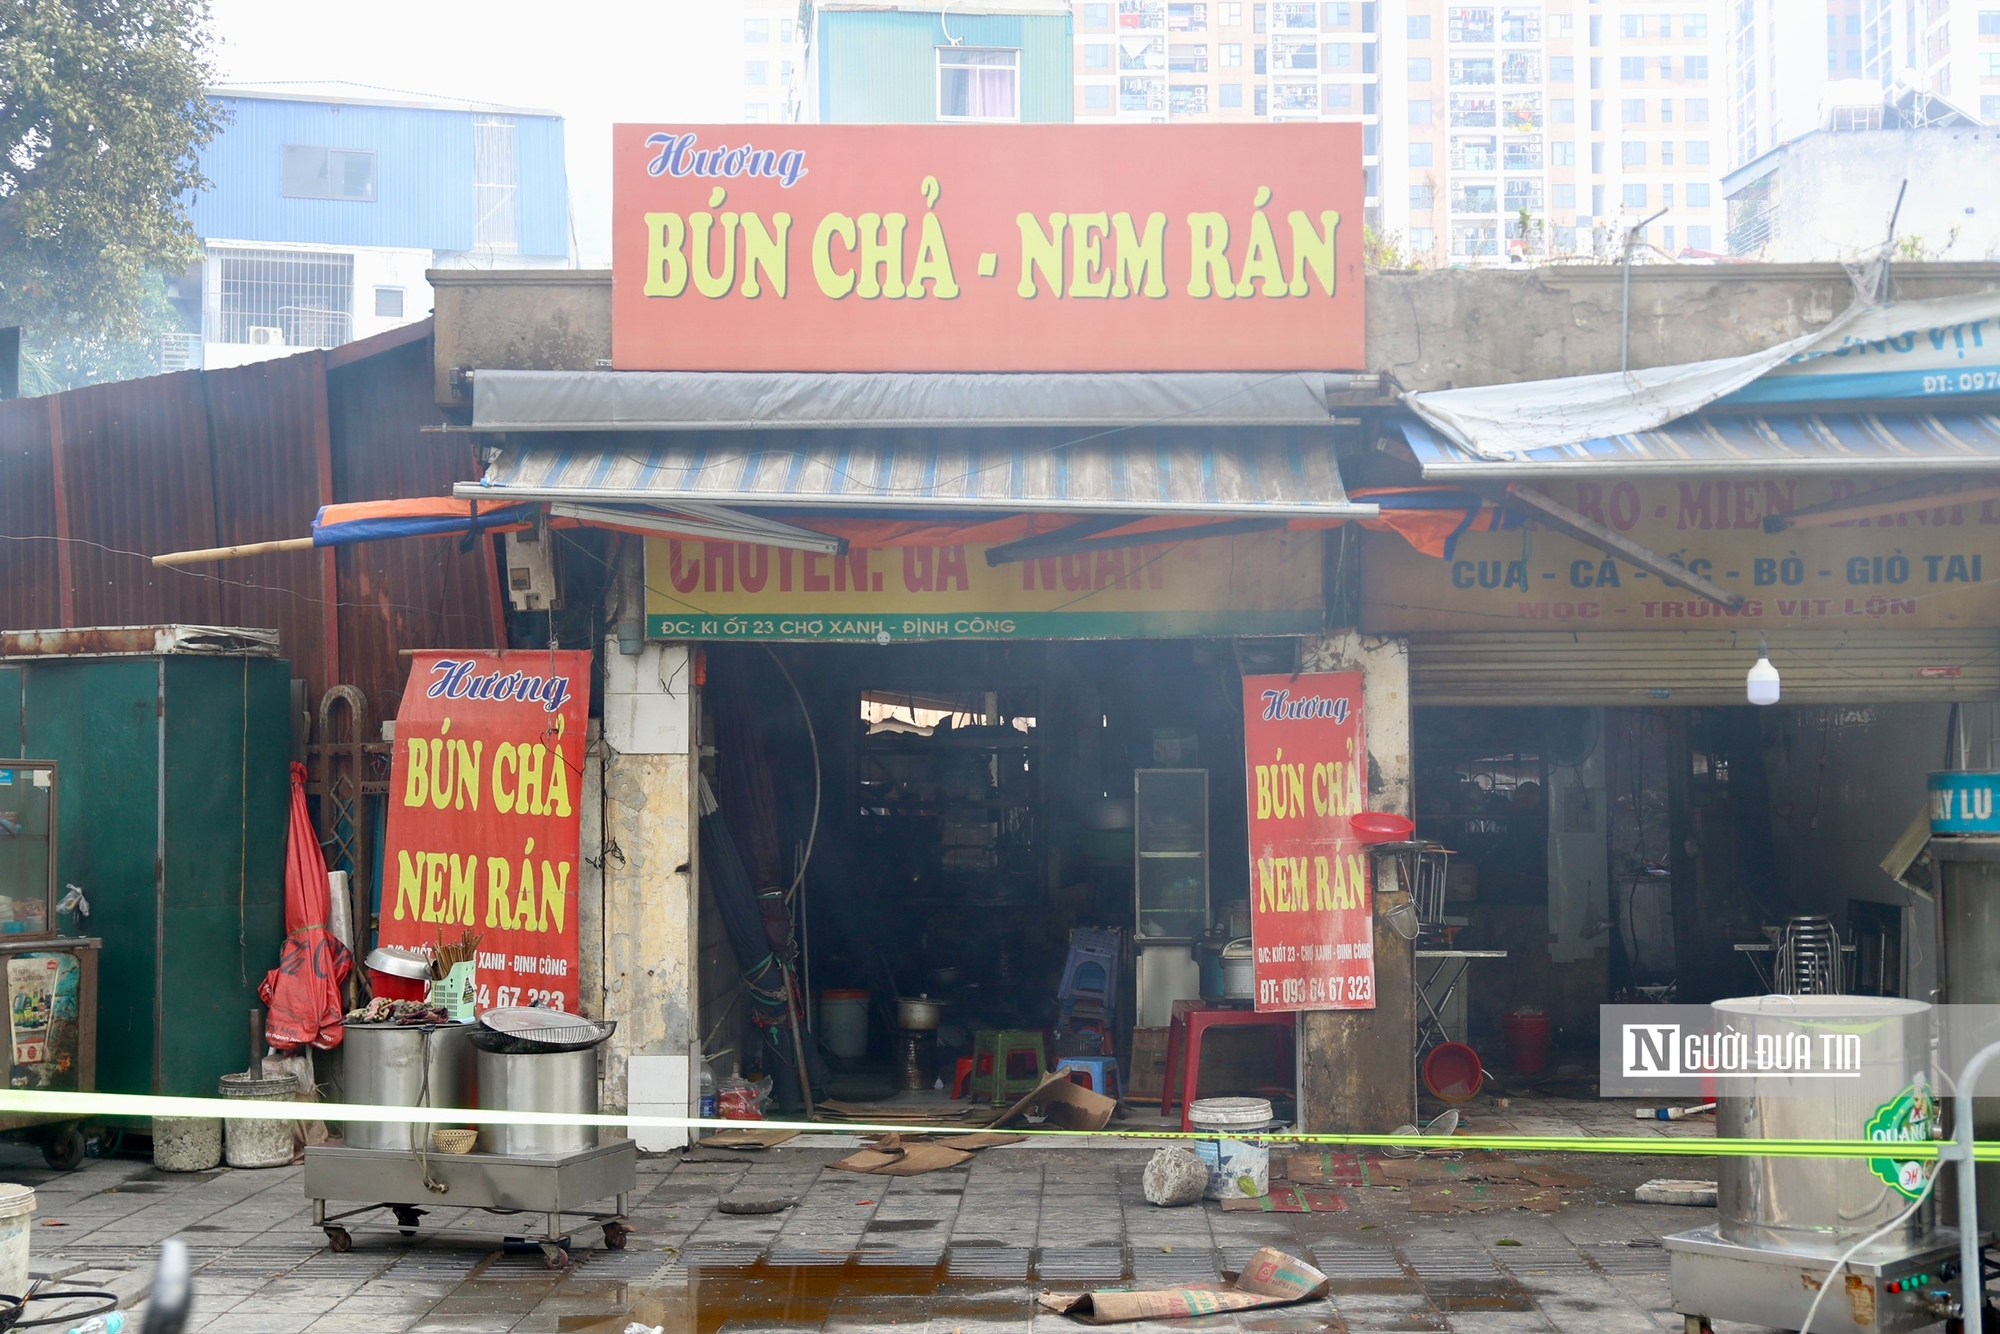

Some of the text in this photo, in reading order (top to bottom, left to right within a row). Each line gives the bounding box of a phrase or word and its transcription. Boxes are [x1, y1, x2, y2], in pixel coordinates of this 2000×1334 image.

[645, 132, 808, 187] Hương
[644, 175, 1340, 298] BÚN CHẢ - NEM RÁN
[1923, 374, 1953, 393] ĐT:
[1452, 560, 1527, 590] CUA
[1754, 549, 1804, 586] BÒ
[1847, 548, 1909, 585] GIÒ
[1923, 554, 1981, 582] TAI
[661, 621, 695, 634] ĐC:
[701, 621, 717, 634] KI
[723, 617, 748, 634] ỐT
[753, 621, 774, 634] 23
[780, 619, 823, 637] CHỢ
[829, 621, 883, 634] XANH
[902, 617, 949, 637] ĐỊNH
[954, 616, 1016, 634] CÔNG
[1776, 599, 1831, 619] VỊT
[426, 659, 572, 712] Hương
[1261, 688, 1350, 724] Hương
[404, 713, 572, 817] BÚN CHẢ
[1255, 736, 1362, 819] BÚN CHẢ
[1961, 788, 1992, 819] LU
[393, 837, 570, 934] NEM RÁN
[1258, 839, 1365, 913] NEM RÁN
[478, 952, 505, 970] XANH
[513, 955, 537, 976] ĐỊNH
[539, 955, 567, 976] CÔNG
[1272, 941, 1286, 962] KIỐT
[1287, 946, 1296, 961] 23
[1315, 944, 1332, 961] XANH
[1336, 943, 1352, 963] ĐỊNH
[1353, 940, 1370, 960] CÔNG
[497, 986, 521, 1008] 67
[1260, 975, 1372, 1004] ĐT: 093 64 67 323
